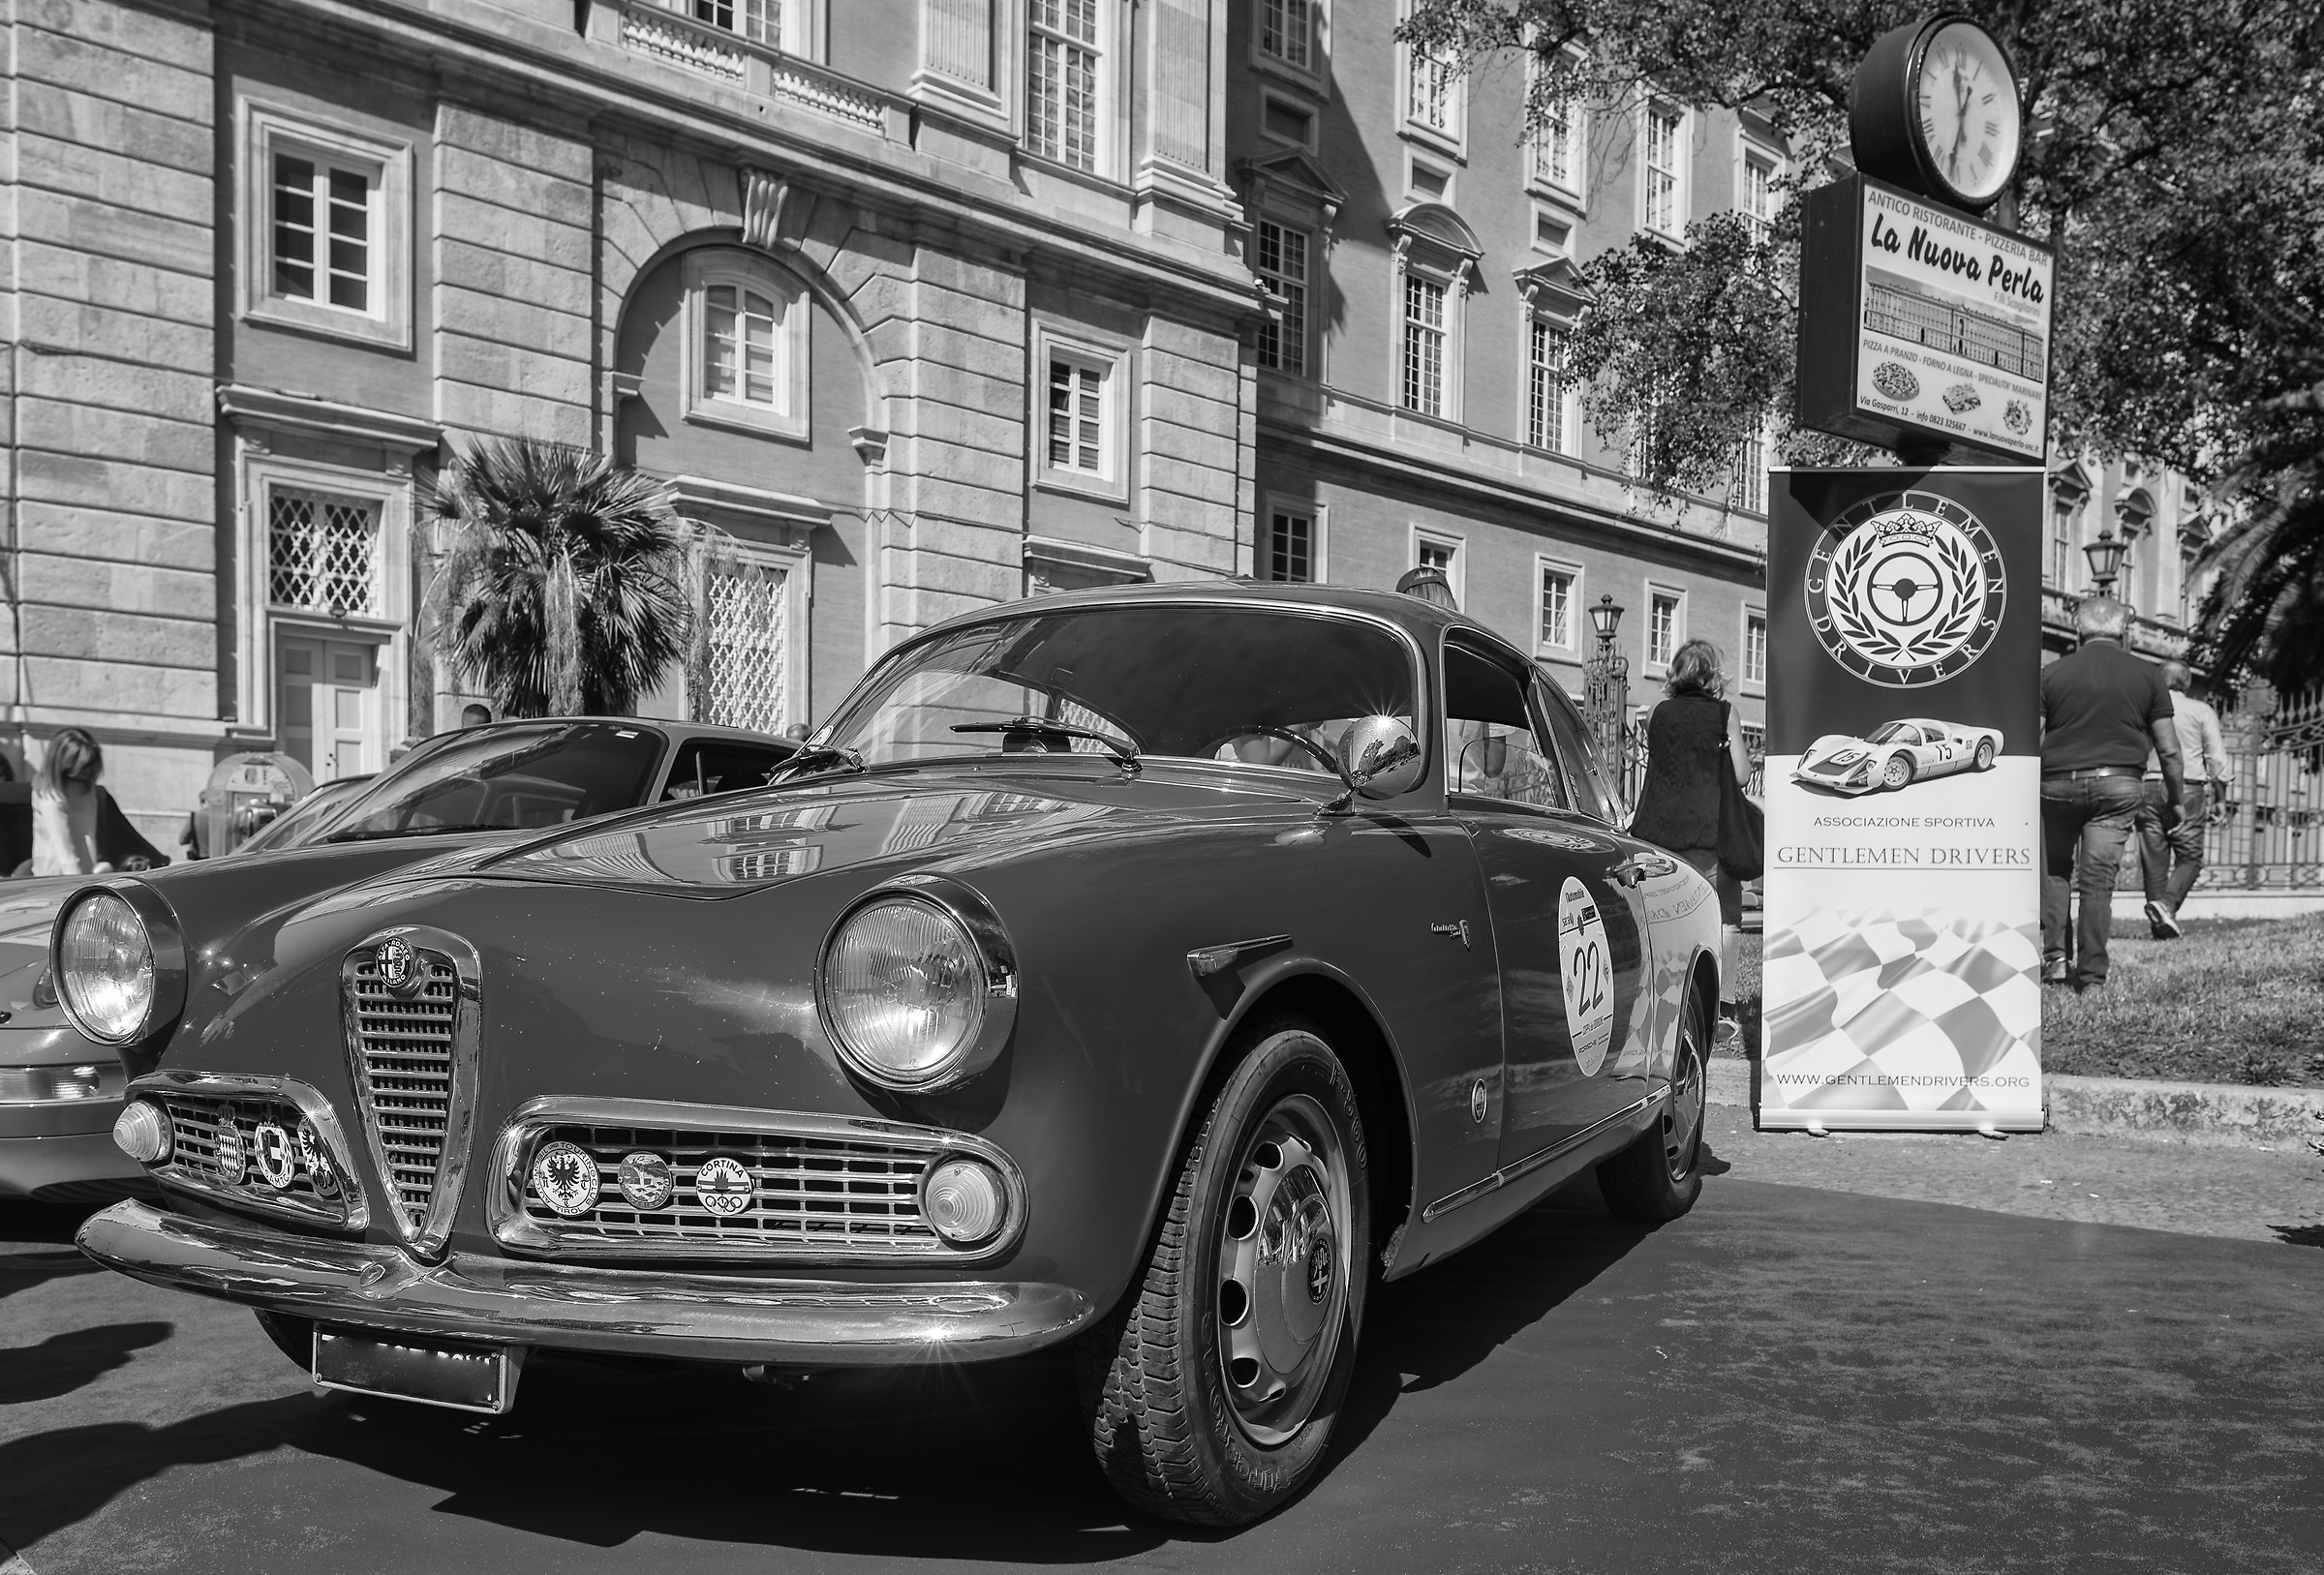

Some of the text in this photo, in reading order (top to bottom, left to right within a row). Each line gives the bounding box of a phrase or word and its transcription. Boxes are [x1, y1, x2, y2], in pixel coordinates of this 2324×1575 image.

[1868, 191, 1911, 216] ANTICO
[1912, 206, 1976, 240] RISTORANTE
[1985, 232, 2027, 259] PIZZERIA
[2029, 250, 2048, 267] BAR
[1871, 213, 2044, 304] La Nuova Perla
[1863, 339, 1882, 352] PIZZA
[1890, 348, 1918, 362] PRANZO
[1923, 356, 1946, 370] FORNO
[1947, 364, 1952, 373] A
[1953, 365, 1973, 379] LEGNA
[1860, 396, 1871, 407] Via
[1901, 407, 1909, 416] 12
[1916, 410, 1928, 423] info
[1929, 414, 1943, 426] 0823
[1944, 418, 1967, 432] 325667
[1808, 492, 2004, 594] GENTLEMEN
[1814, 616, 1997, 685] DRIVERS
[1935, 743, 1953, 762] 15
[1813, 817, 1996, 828] ASSOCIAZIONE SPORTIVA
[1777, 846, 2032, 865] GENTLEMEN DRIVERS
[382, 974, 406, 984] MILANO
[1573, 940, 1605, 1016] 22
[1777, 1074, 2031, 1088] WWW.GENTLEMENDRIVERS.ORG
[701, 1160, 745, 1179] CORTINA
[555, 1205, 583, 1215] TIROL
